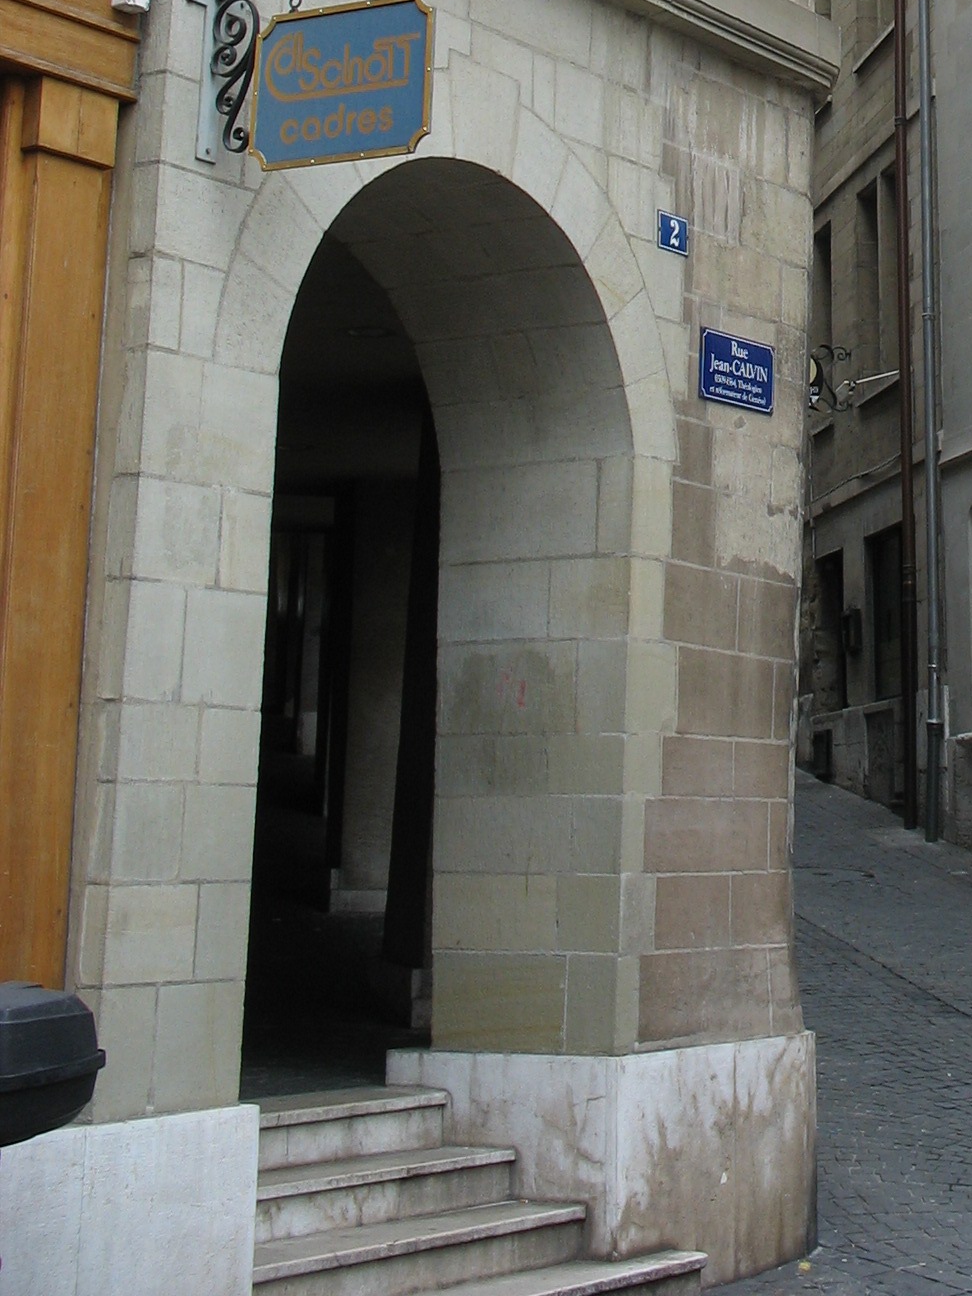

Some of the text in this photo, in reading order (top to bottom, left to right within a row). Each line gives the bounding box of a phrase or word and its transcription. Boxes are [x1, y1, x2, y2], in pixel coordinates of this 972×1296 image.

[279, 103, 393, 145] cadres
[670, 219, 680, 247] 2
[731, 341, 748, 359] Rue
[709, 353, 768, 383] Jean-CALVIN
